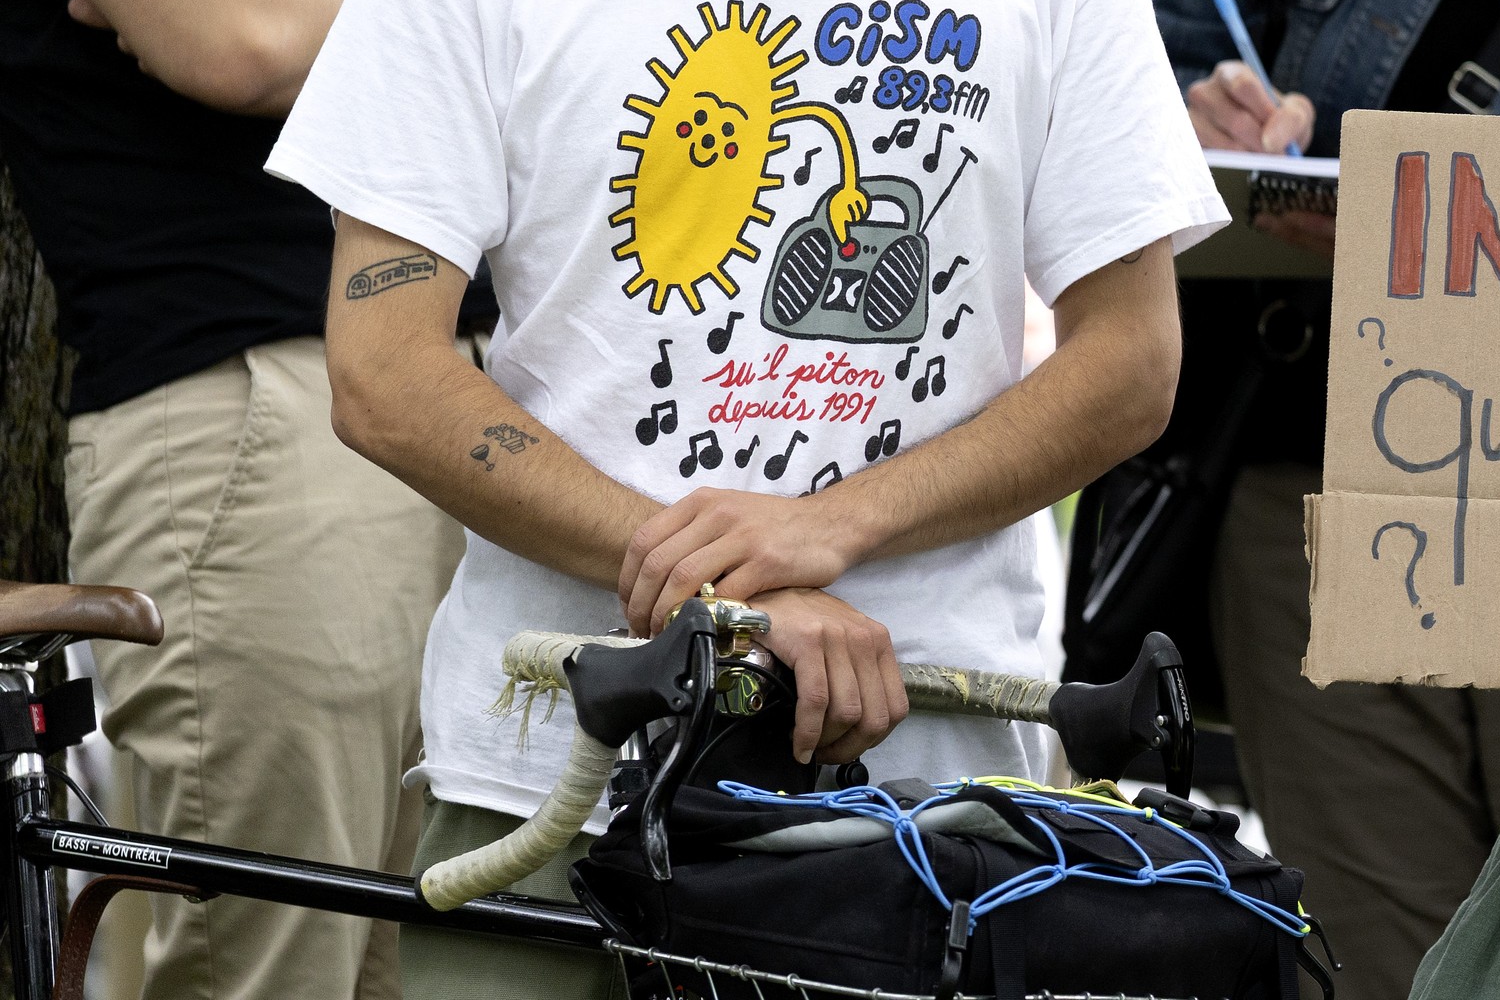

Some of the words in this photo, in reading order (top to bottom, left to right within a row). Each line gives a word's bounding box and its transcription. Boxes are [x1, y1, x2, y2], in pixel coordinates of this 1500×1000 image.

[1357, 317, 1394, 366] ?
[785, 351, 885, 398] piton
[708, 391, 815, 432] depuis
[812, 393, 878, 424] 1991
[1371, 520, 1436, 630] ?
[58, 834, 90, 852] BASSI
[102, 843, 162, 864] MONTRÉAL
